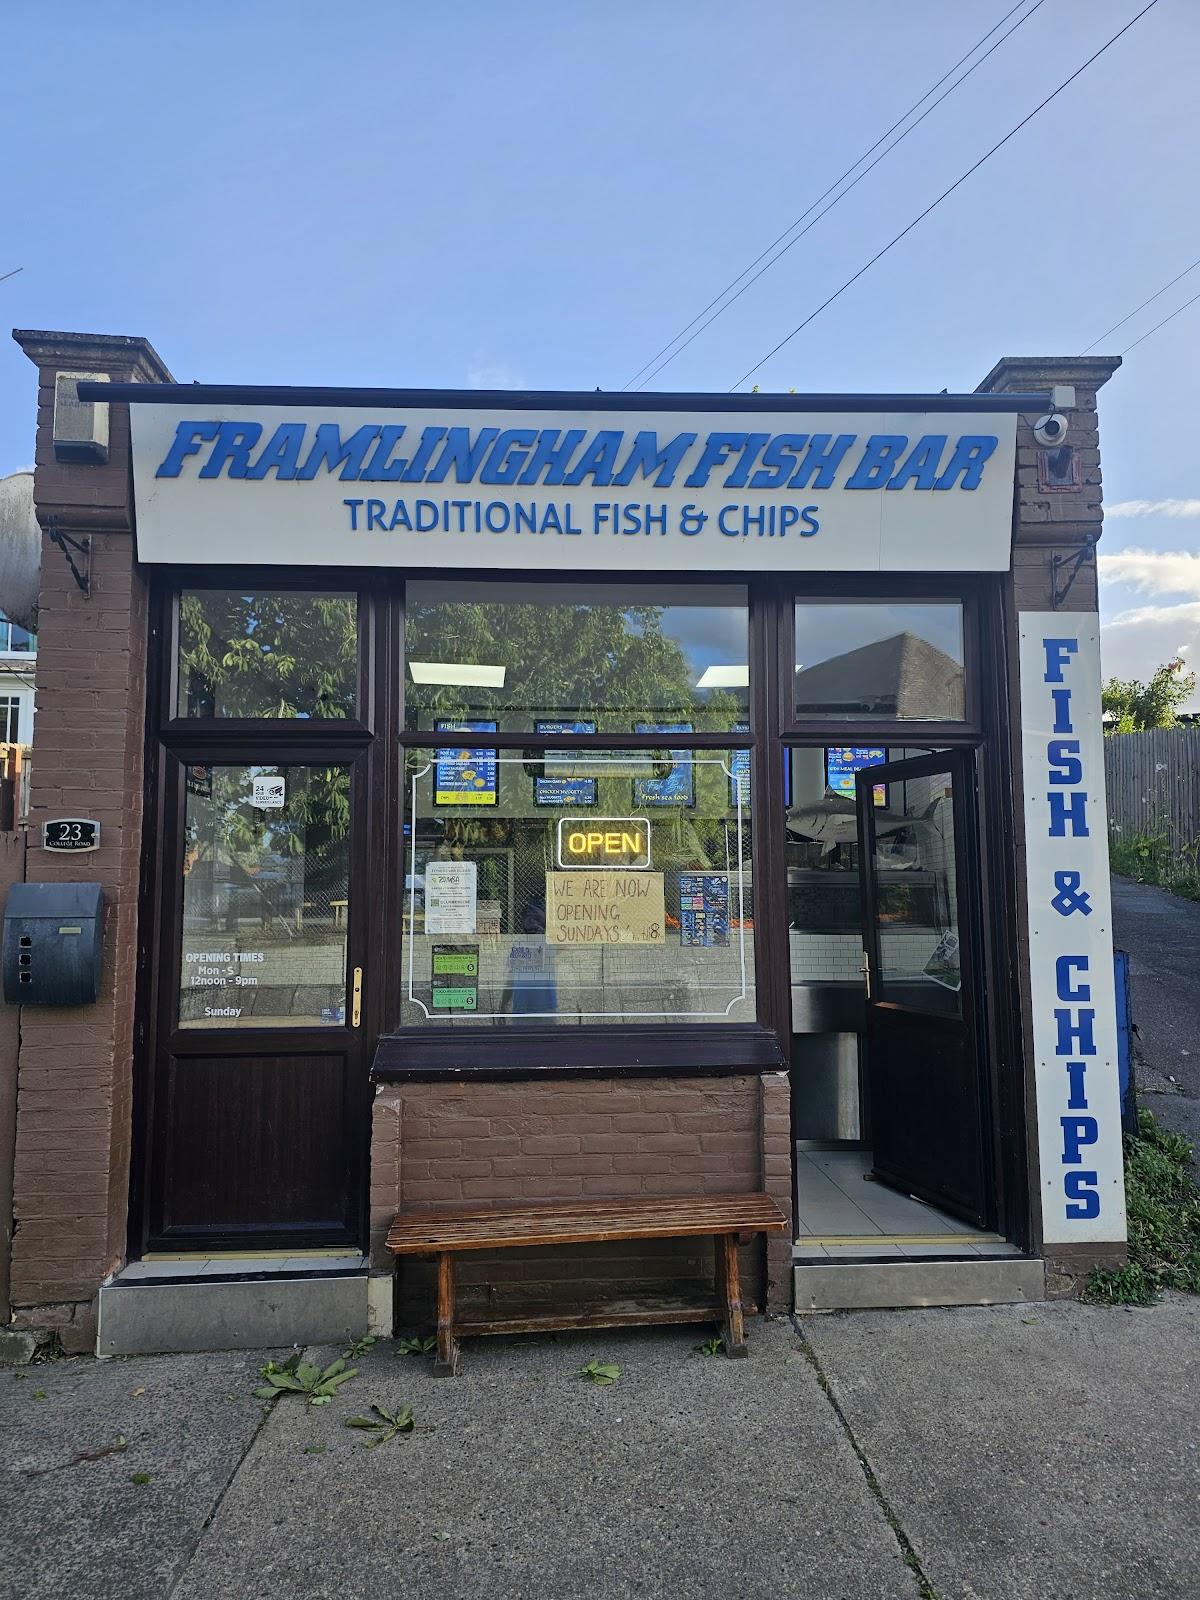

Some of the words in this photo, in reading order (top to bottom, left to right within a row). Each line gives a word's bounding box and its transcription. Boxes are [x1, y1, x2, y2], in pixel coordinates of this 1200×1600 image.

[156, 420, 698, 488] FRAMLINGHAM
[684, 432, 857, 489] FISH
[844, 434, 999, 491] BAR
[344, 499, 582, 534] TRADITIONAL
[594, 503, 667, 535] FISH
[680, 505, 709, 536] &
[719, 505, 820, 537] CHIPS
[1042, 638, 1090, 838] FISH
[59, 824, 82, 841] 23
[568, 832, 641, 854] OPEN
[554, 880, 574, 897] WE
[583, 880, 608, 898] ARE
[615, 880, 651, 898] NOW
[1051, 870, 1093, 917] &
[557, 903, 621, 921] OPENING
[556, 925, 620, 942] SUNDAYS
[185, 952, 231, 963] OPENING
[232, 952, 265, 962] TIMES
[198, 965, 219, 975] Mon
[190, 976, 226, 985] 12noon
[235, 976, 258, 986] 9pm
[204, 1006, 242, 1017] Sunday
[1055, 955, 1102, 1220] CHIPS
